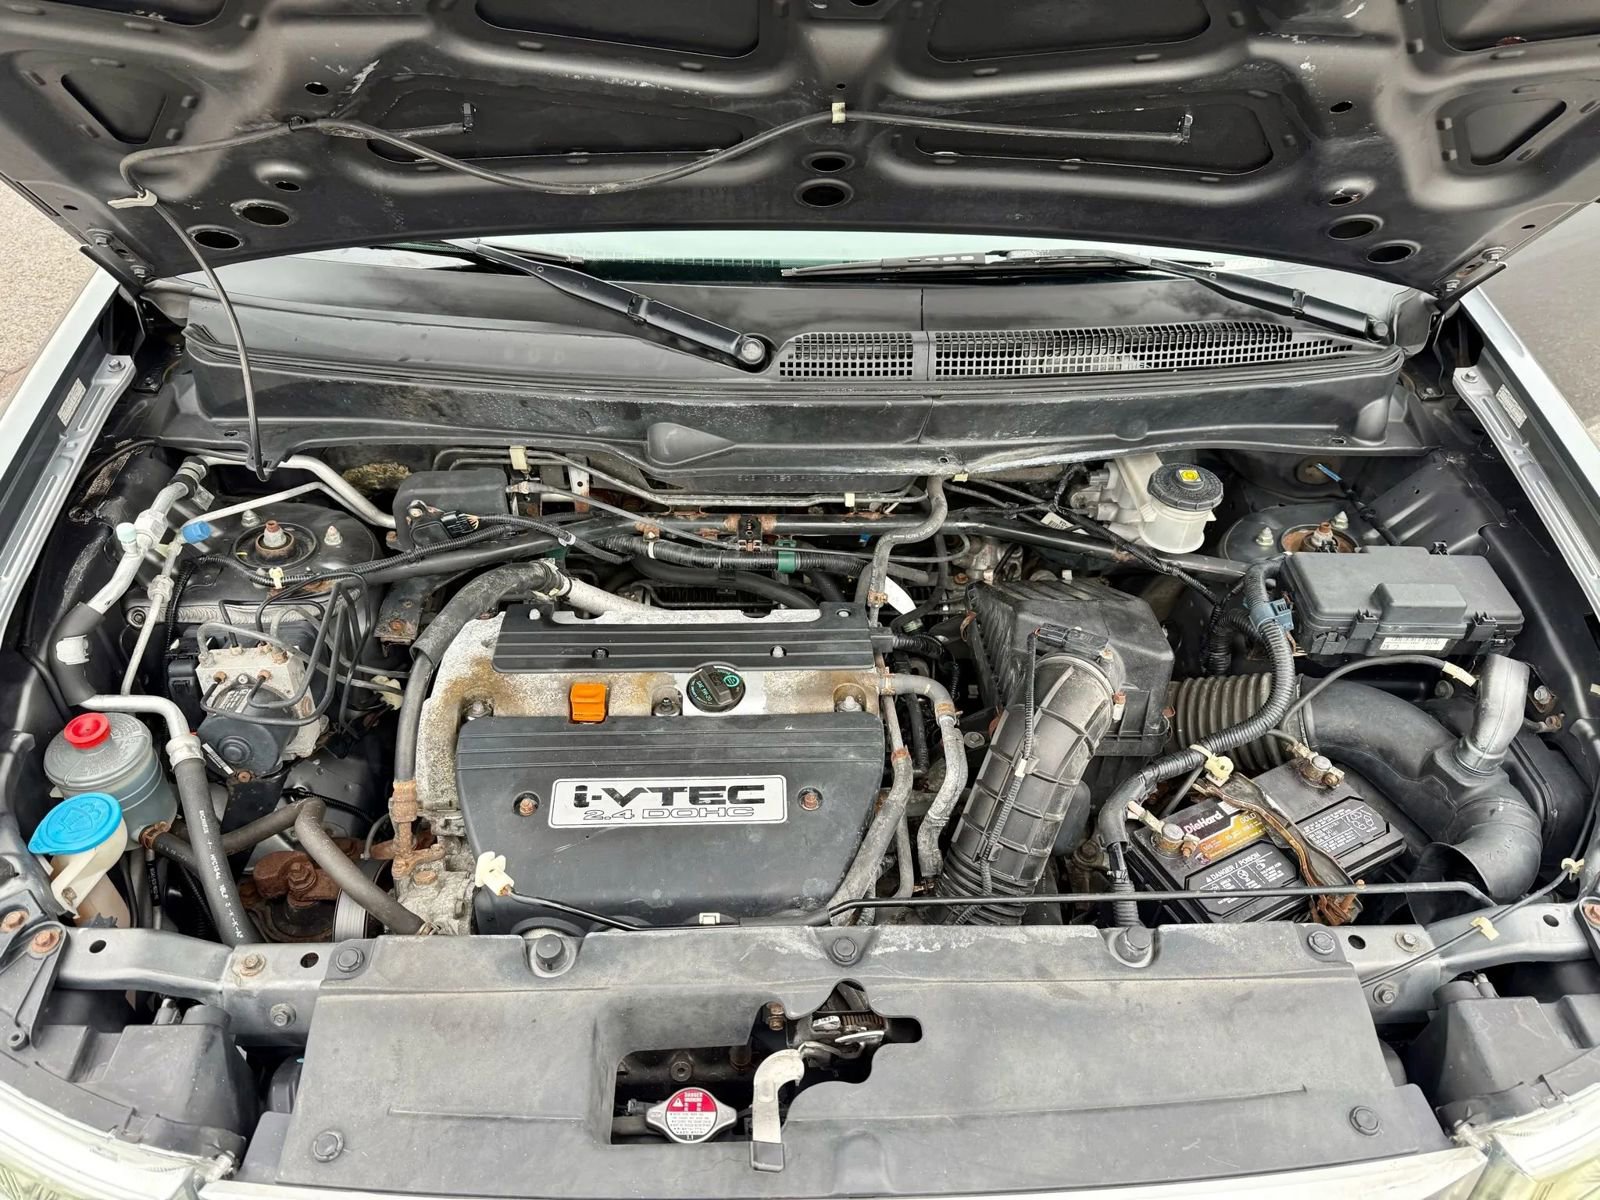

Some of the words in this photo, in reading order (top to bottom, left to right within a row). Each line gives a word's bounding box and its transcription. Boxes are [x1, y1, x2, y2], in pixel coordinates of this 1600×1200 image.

[573, 784, 765, 808] i-VTEC
[583, 808, 636, 821] 2.4
[642, 806, 755, 820] DOHC
[1183, 810, 1225, 834] DieHard
[1210, 864, 1236, 880] DANGER
[1238, 851, 1261, 866] POISON
